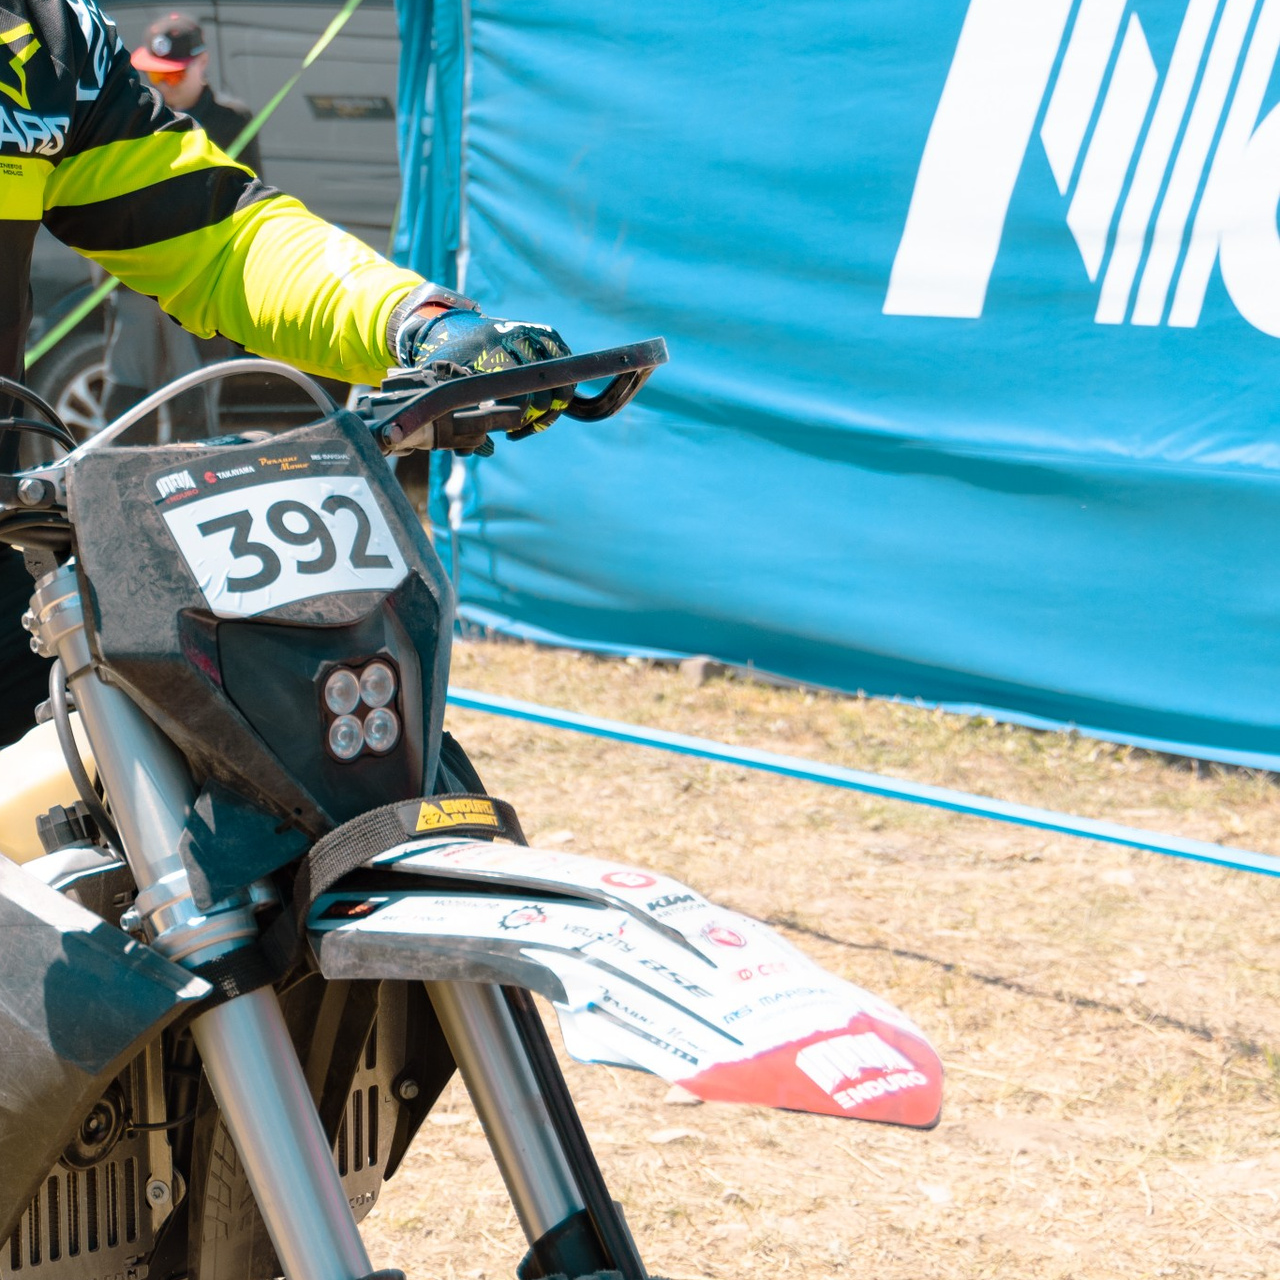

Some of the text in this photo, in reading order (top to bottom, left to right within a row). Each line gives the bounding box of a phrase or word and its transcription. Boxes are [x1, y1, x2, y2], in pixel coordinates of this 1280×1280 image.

[217, 465, 256, 479] TAKAYAMA
[196, 494, 394, 593] 392
[646, 893, 696, 912] KTM
[832, 1071, 928, 1110] ENDURO
